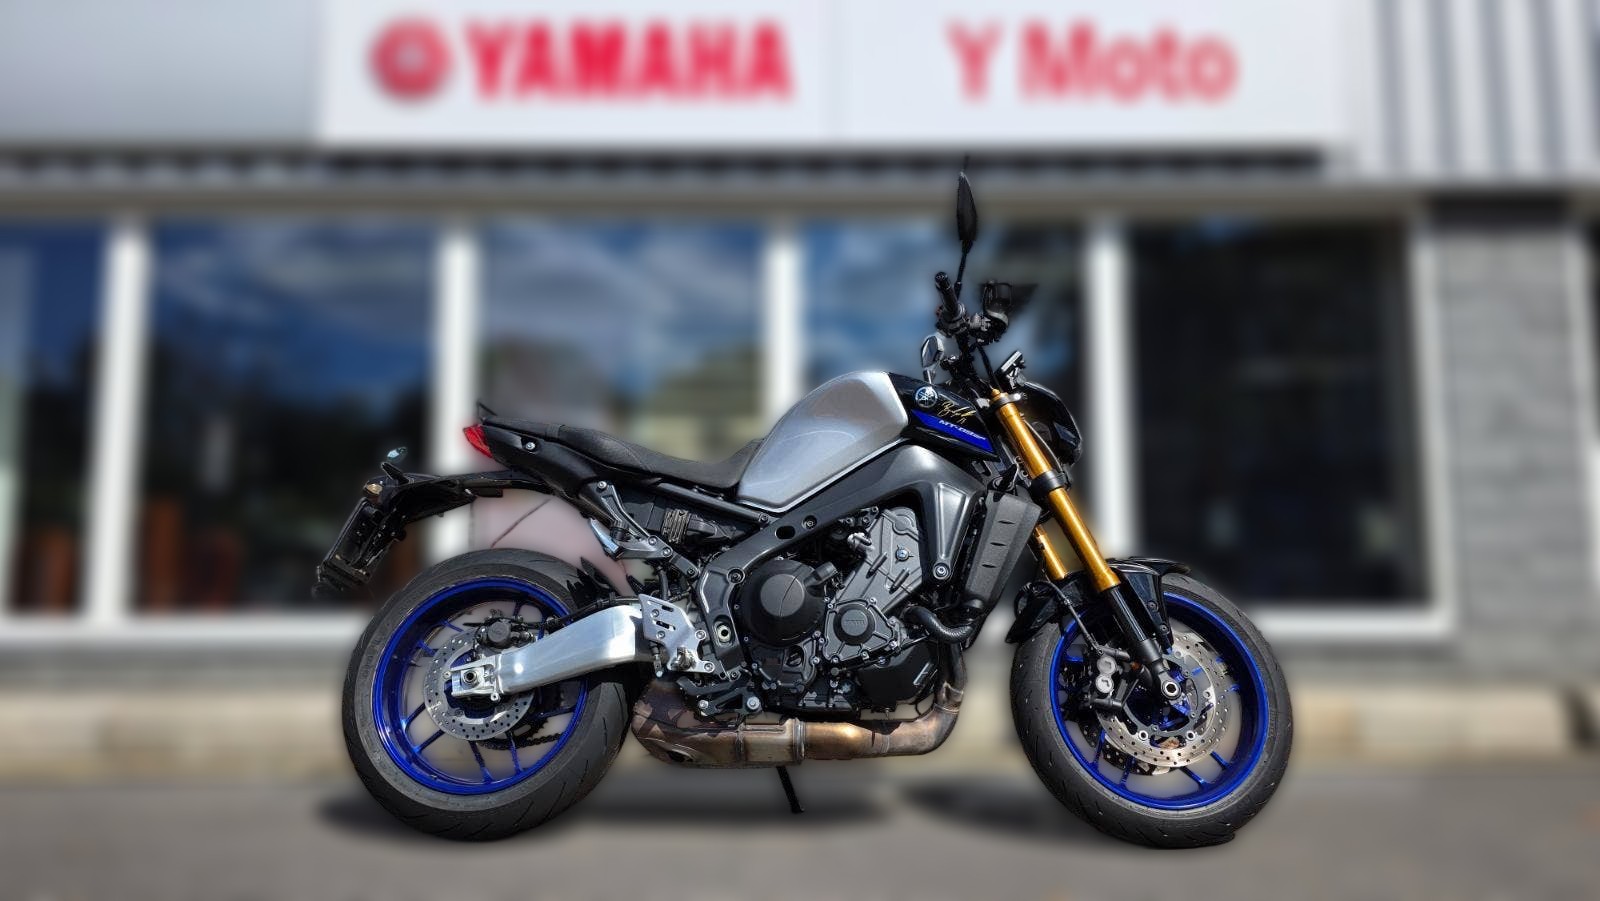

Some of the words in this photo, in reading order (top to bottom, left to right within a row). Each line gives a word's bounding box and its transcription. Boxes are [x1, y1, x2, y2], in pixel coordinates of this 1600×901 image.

[465, 21, 792, 101] YAMAHA
[948, 24, 1000, 100] Y
[1019, 22, 1237, 102] Moto
